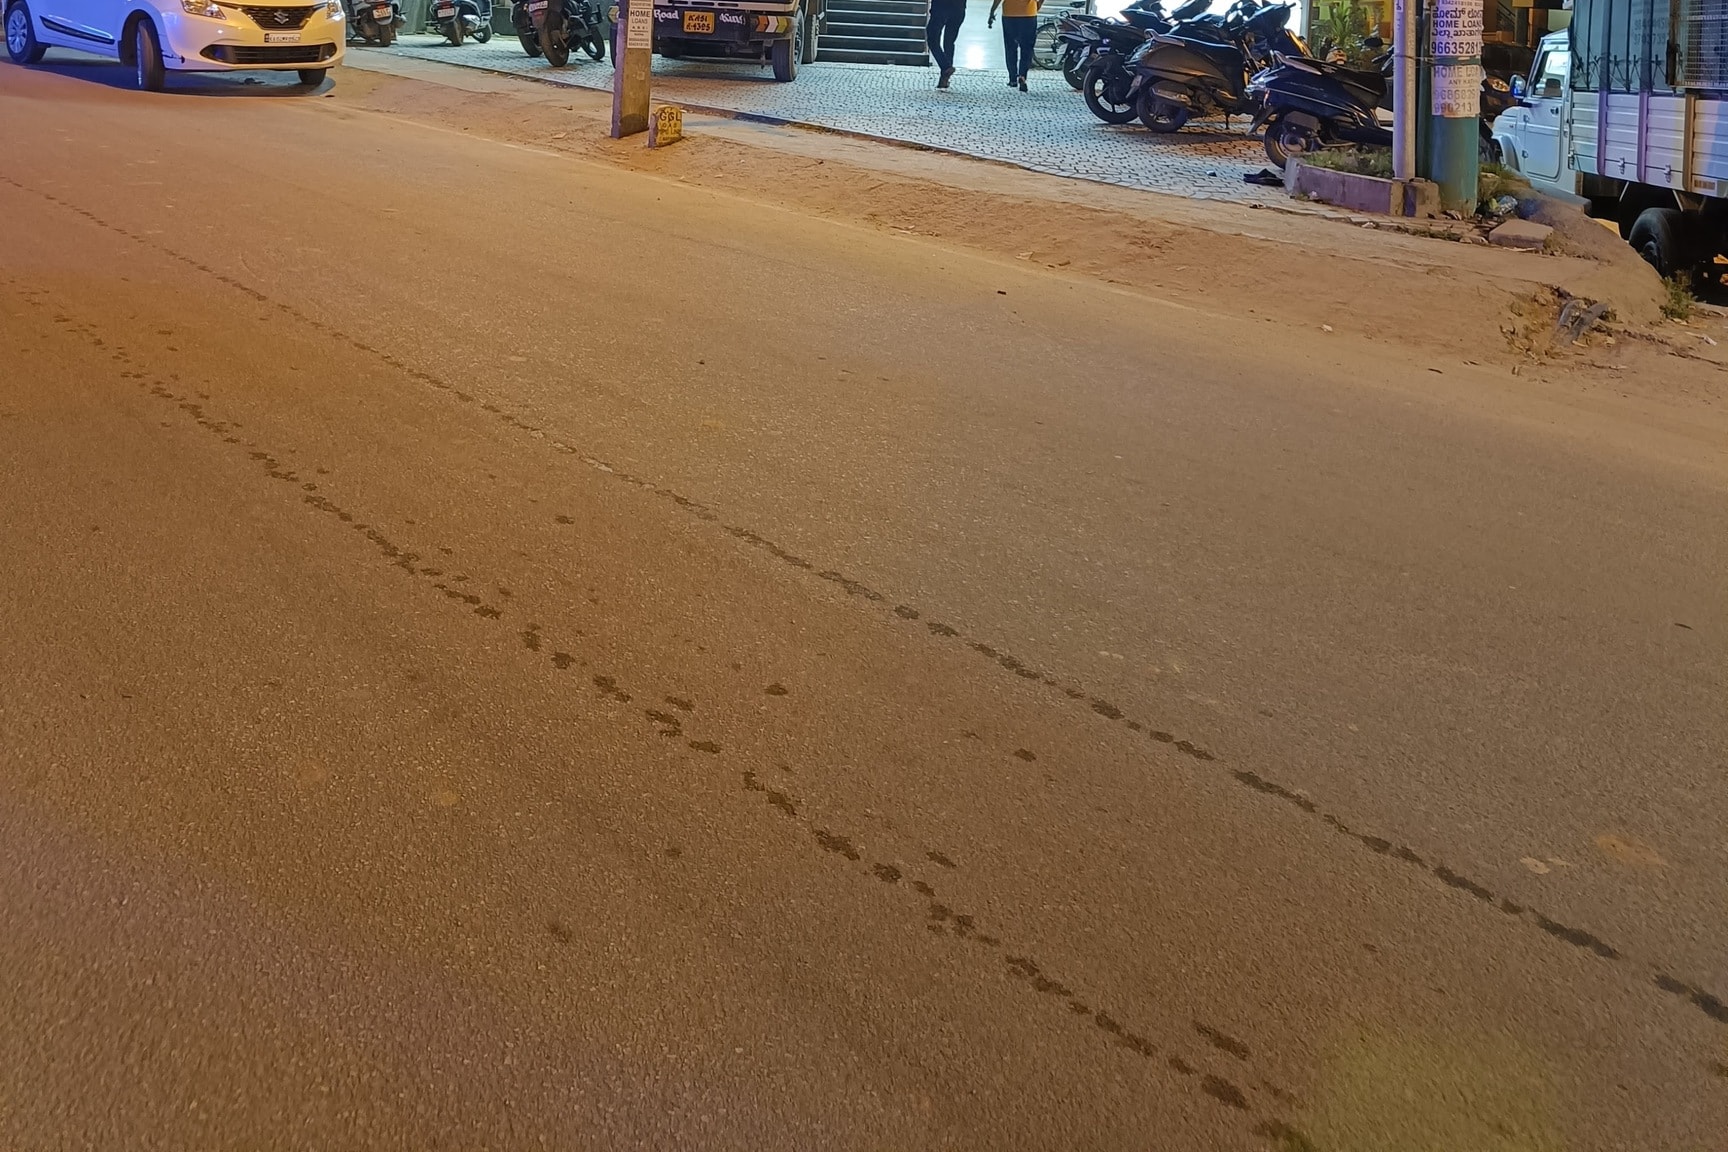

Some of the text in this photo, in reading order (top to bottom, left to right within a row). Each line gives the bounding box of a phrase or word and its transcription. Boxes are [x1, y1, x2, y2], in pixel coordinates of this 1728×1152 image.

[630, 10, 651, 18] HOME
[654, 8, 680, 23] Road
[1432, 19, 1460, 28] HOME
[1433, 66, 1463, 78] HOME
[660, 111, 681, 122] GGL
